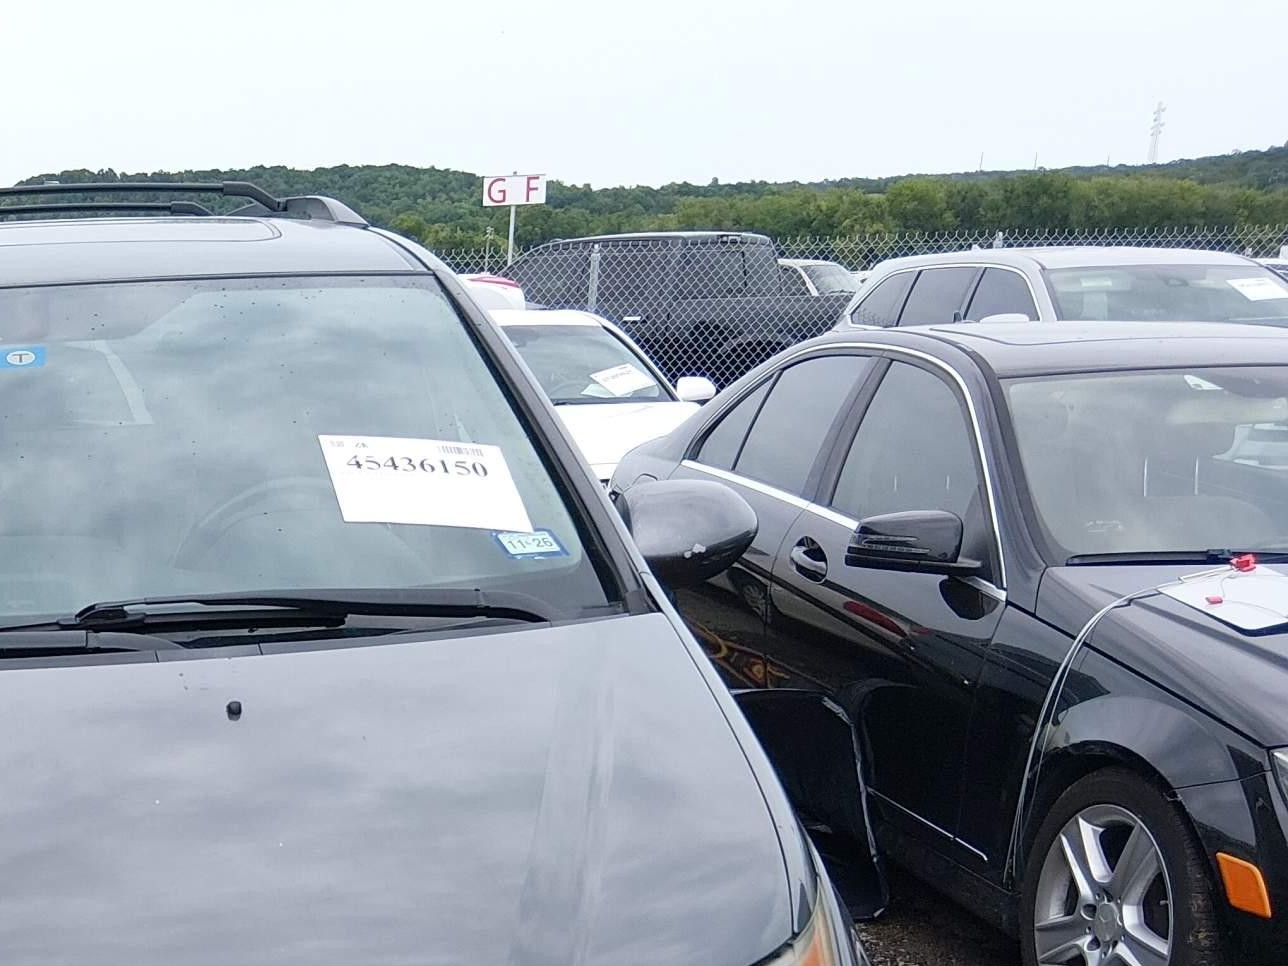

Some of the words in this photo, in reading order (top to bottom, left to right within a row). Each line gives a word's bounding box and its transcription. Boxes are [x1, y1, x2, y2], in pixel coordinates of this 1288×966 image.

[488, 178, 506, 203] G
[526, 176, 540, 202] F
[346, 454, 489, 477] 45436150
